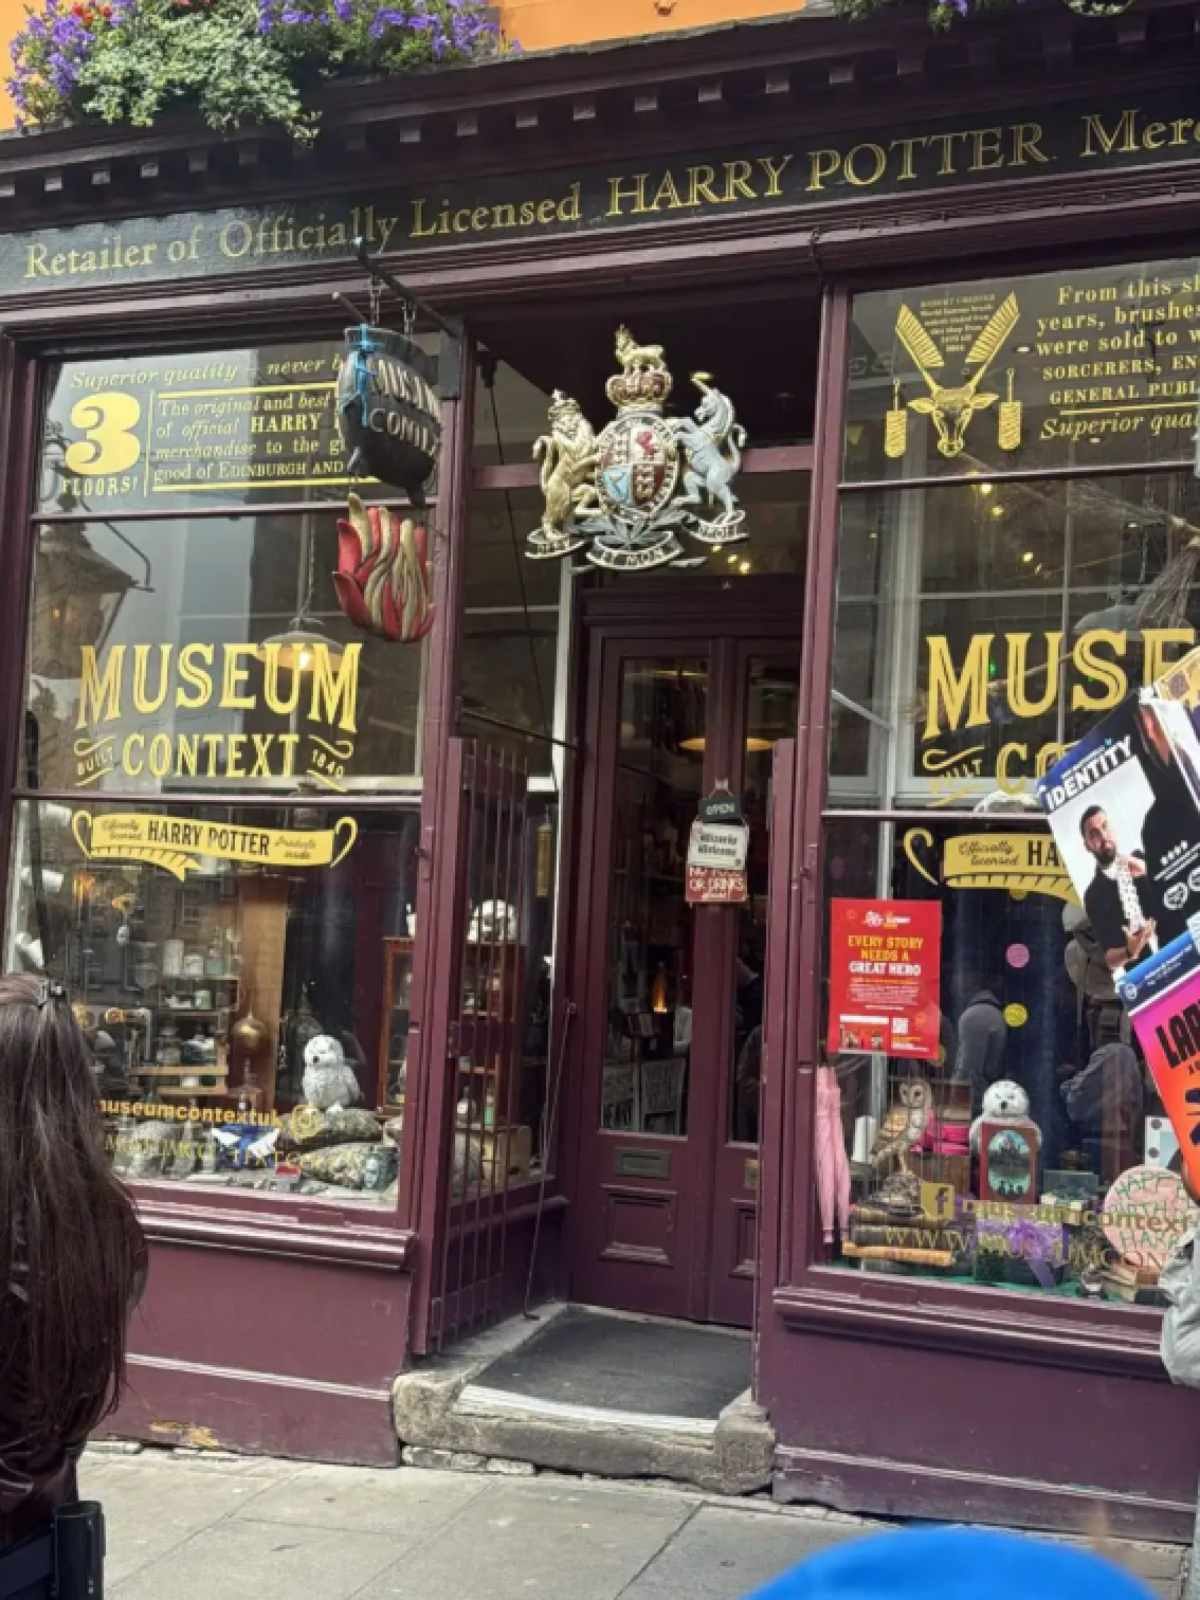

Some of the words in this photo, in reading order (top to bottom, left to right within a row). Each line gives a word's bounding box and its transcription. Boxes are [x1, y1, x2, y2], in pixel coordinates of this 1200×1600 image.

[24, 240, 157, 279] Retailer
[168, 228, 200, 261] of
[219, 206, 399, 258] Officially
[409, 183, 583, 238] Licensed
[606, 155, 792, 218] HARRY
[805, 121, 1048, 193] POTTER
[1058, 284, 1117, 305] From
[1127, 277, 1171, 299] this
[1037, 314, 1106, 337] years,
[1037, 340, 1089, 356] were
[1099, 329, 1145, 352] sold
[1155, 330, 1178, 346] to
[70, 363, 159, 390] Superior
[163, 358, 238, 386] quality
[267, 357, 321, 377] never
[1043, 360, 1163, 381] SORCERERS,
[157, 397, 189, 417] The
[193, 393, 260, 418] original
[263, 394, 294, 413] and
[297, 387, 329, 410] best
[1049, 385, 1140, 405] GENERAL
[64, 392, 140, 476] 3
[156, 423, 171, 439] of
[181, 418, 240, 438] official
[251, 413, 321, 434] HARRY
[1041, 417, 1142, 441] Superior
[153, 442, 256, 461] merchandise
[266, 442, 282, 456] to
[292, 439, 319, 456] the
[196, 462, 213, 480] of
[218, 461, 306, 480] EDINBURGH
[312, 458, 344, 475] AND
[74, 641, 363, 733] MUSEUM
[122, 733, 300, 778] CONTEXT
[1048, 736, 1133, 812] IDENTITY
[147, 821, 200, 848] HARRY
[207, 826, 271, 858] POTTER
[848, 935, 882, 948] EVERY
[886, 936, 923, 949] STORY
[849, 961, 885, 976] GREAT
[888, 963, 921, 977] HERO
